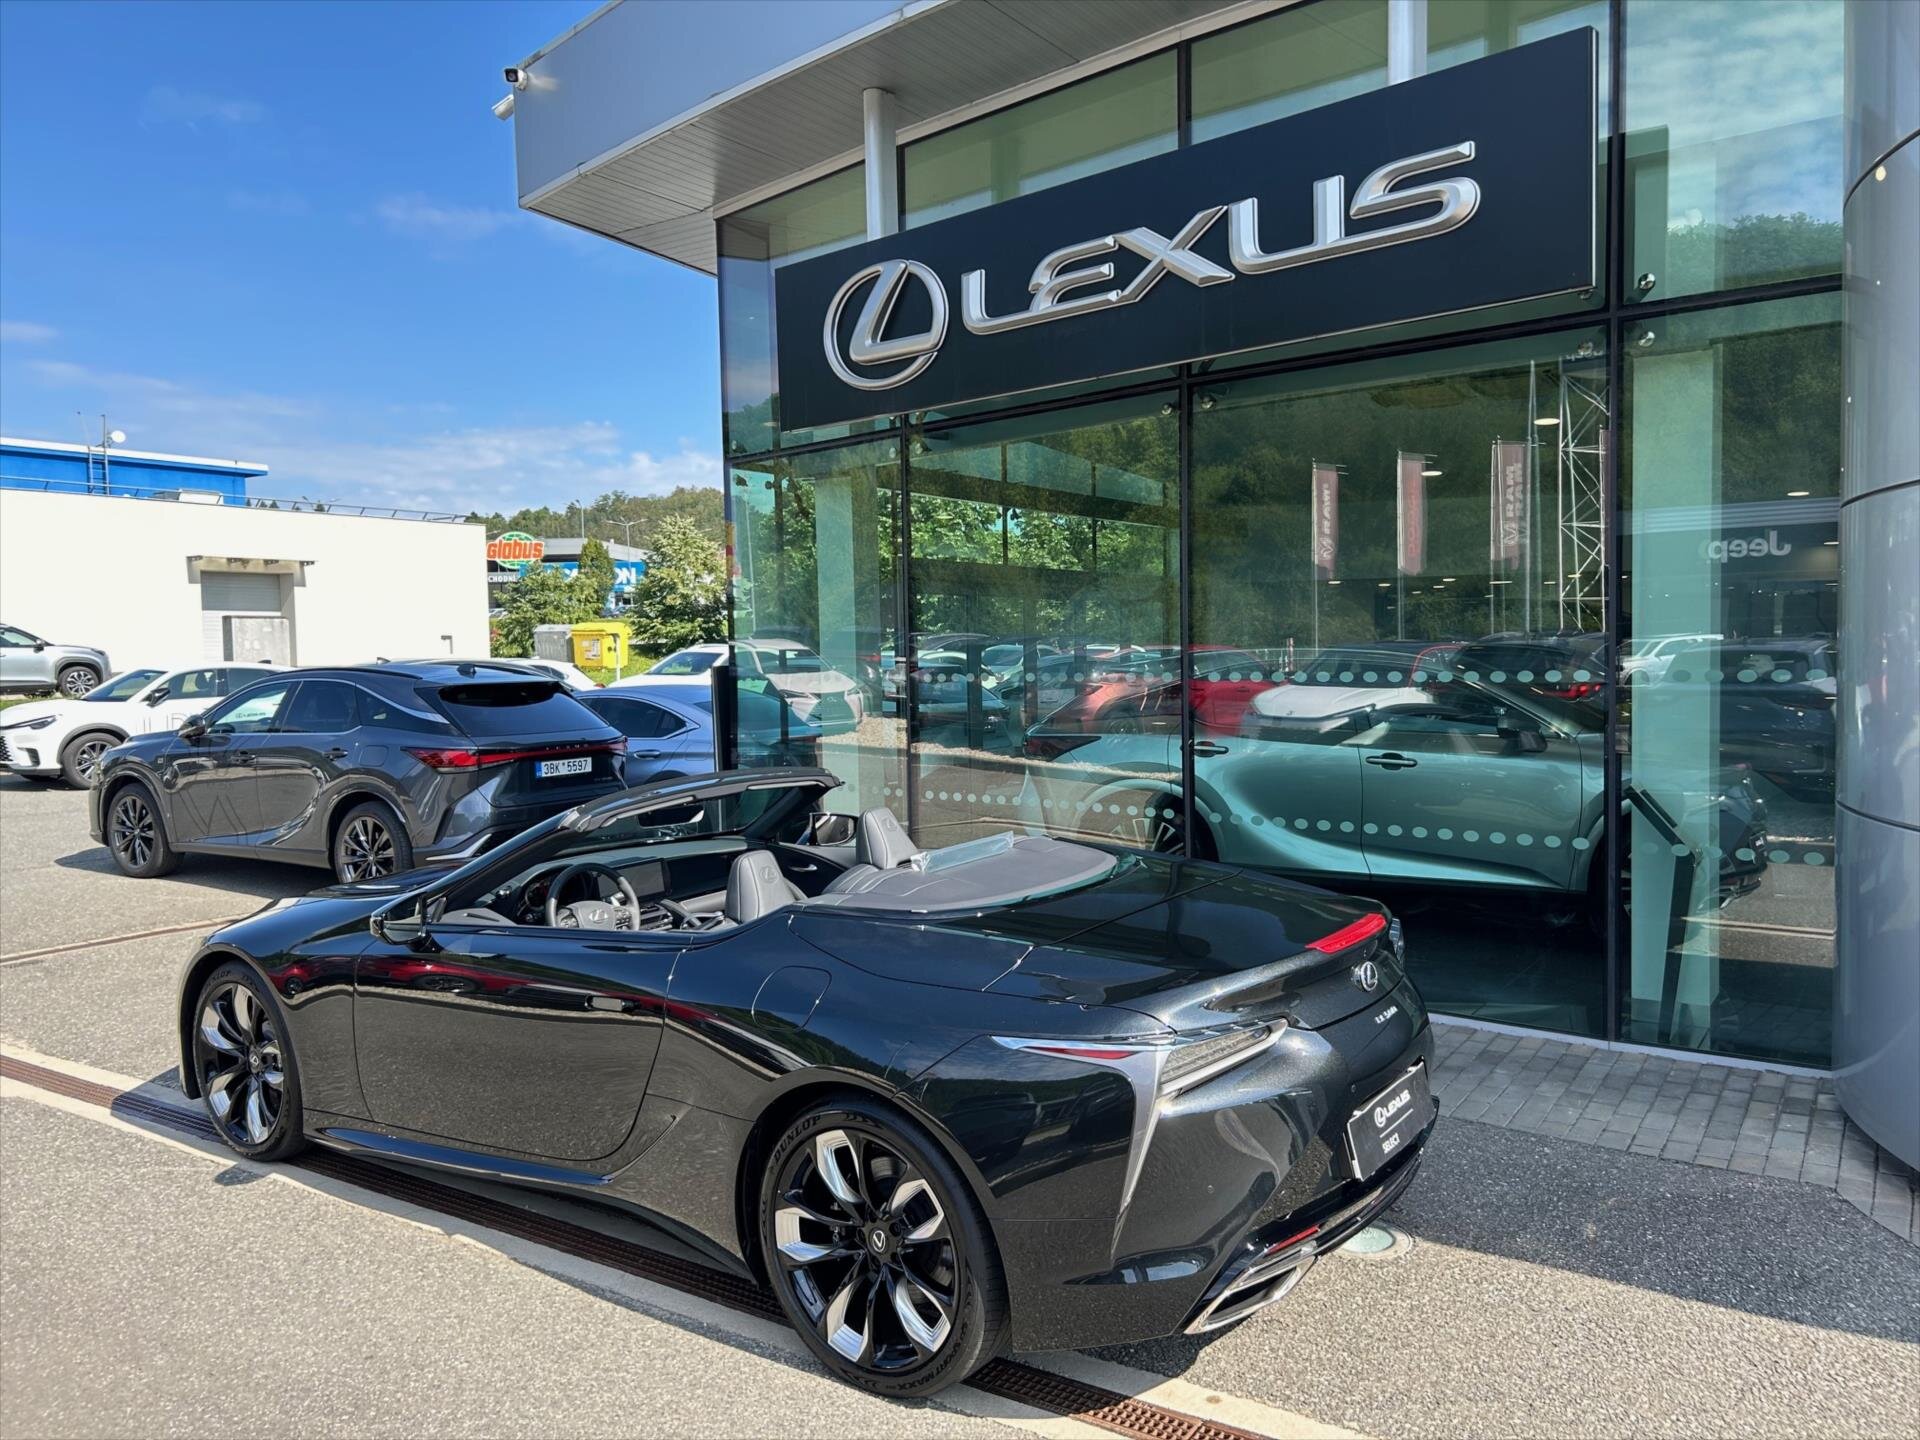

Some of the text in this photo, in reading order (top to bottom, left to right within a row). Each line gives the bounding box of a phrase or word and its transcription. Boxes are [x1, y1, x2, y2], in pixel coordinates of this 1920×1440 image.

[962, 141, 1481, 335] LEXUS
[487, 539, 543, 559] Globus
[544, 762, 560, 775] 3BK
[567, 760, 588, 772] 5597
[774, 1115, 821, 1163] DUNLOP
